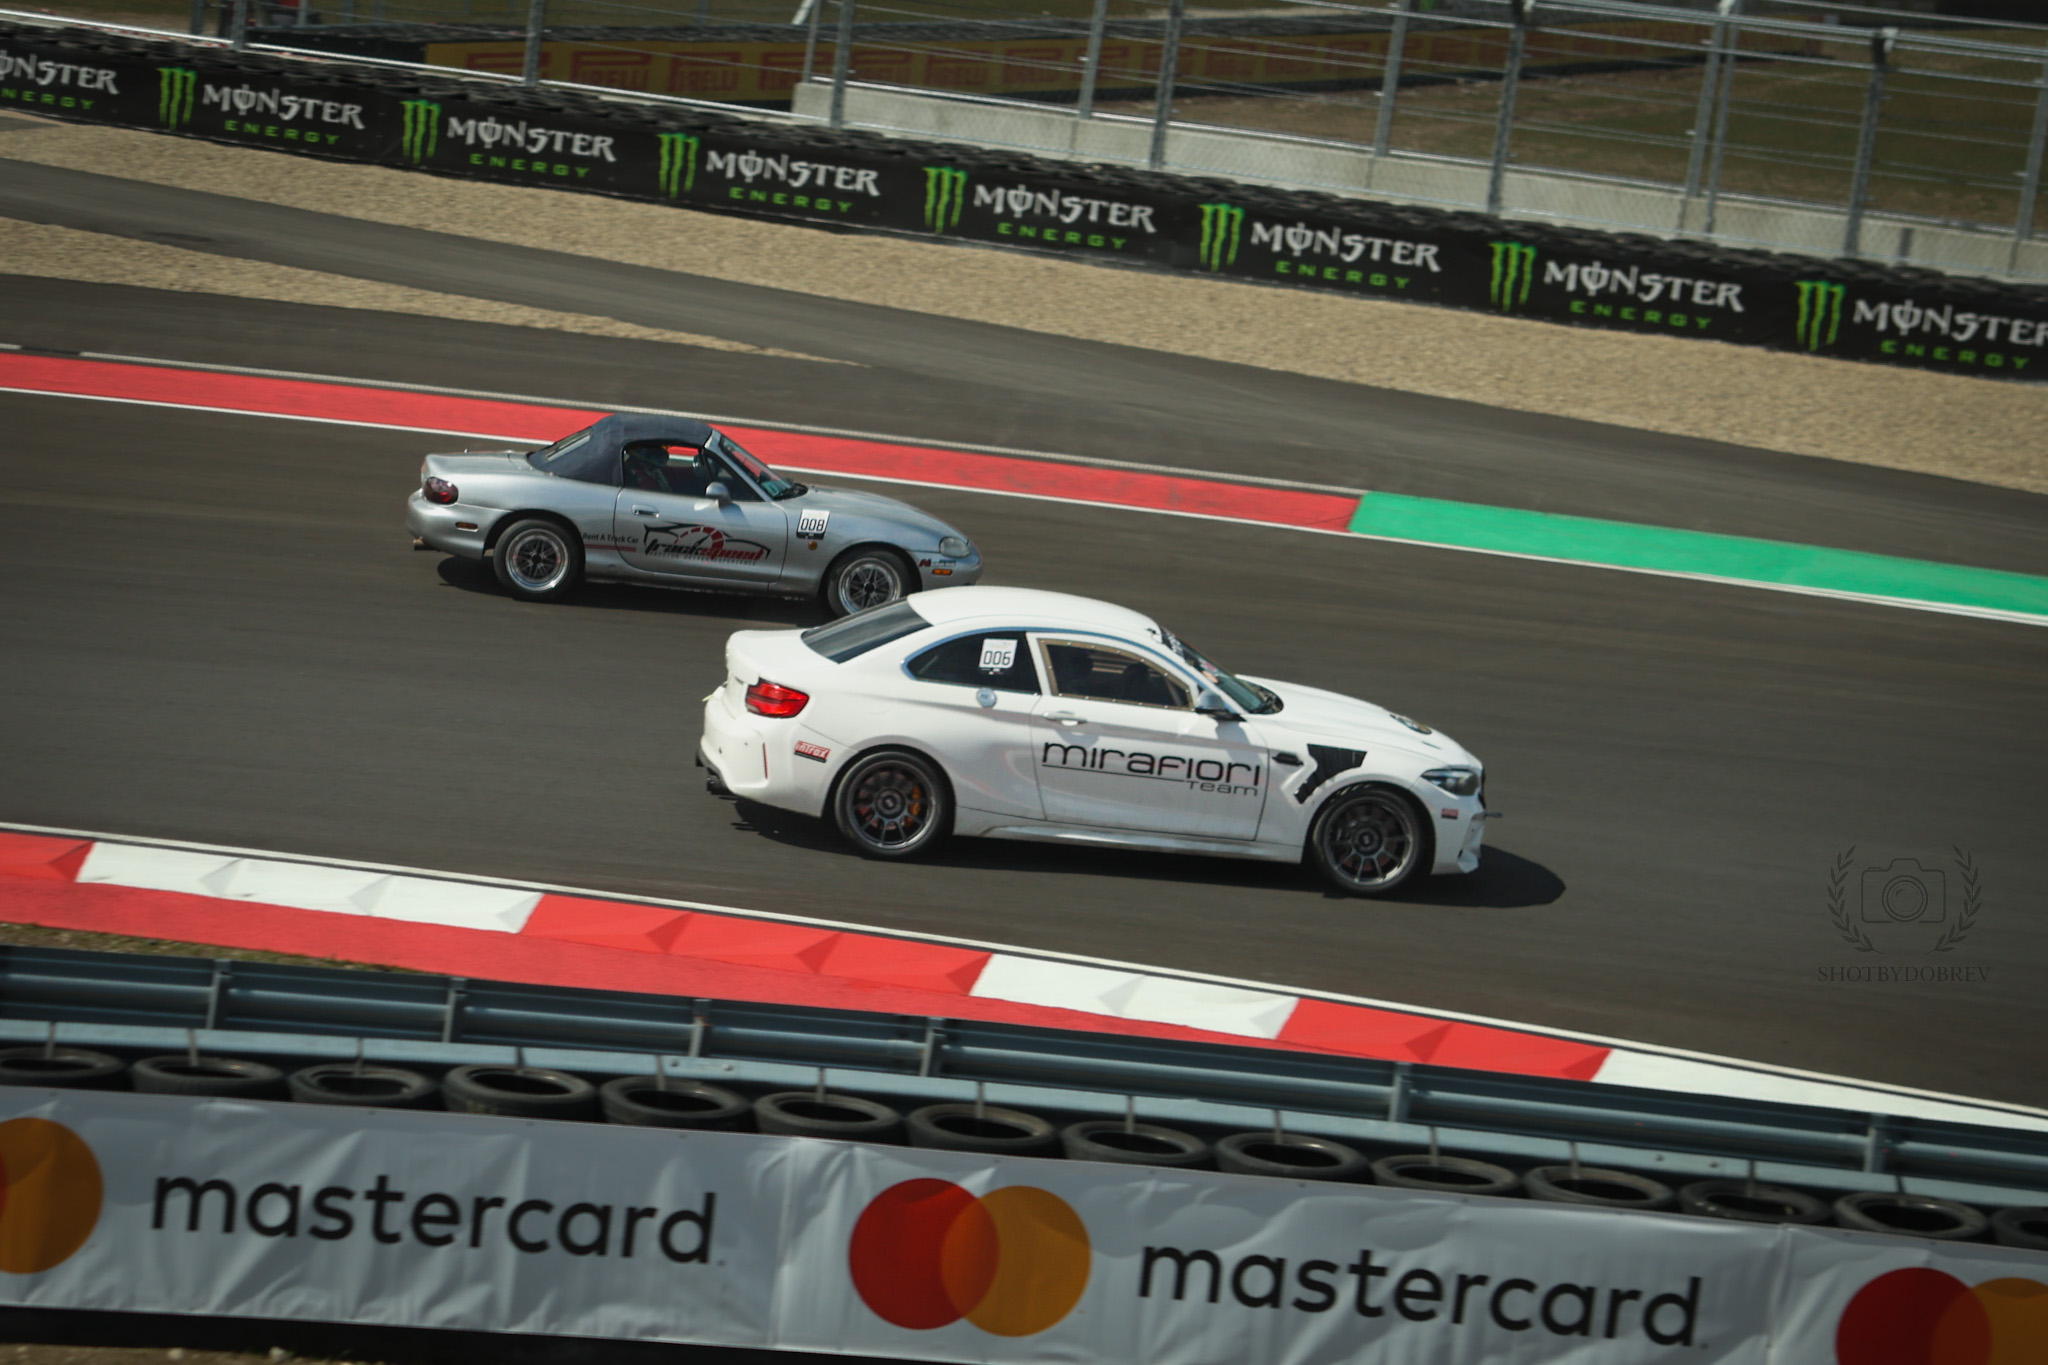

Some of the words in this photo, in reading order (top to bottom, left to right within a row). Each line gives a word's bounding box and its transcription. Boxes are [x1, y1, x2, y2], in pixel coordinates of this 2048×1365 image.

[0, 50, 119, 95] ONSTER
[1, 88, 94, 109] NERGY
[202, 83, 365, 130] MONSTER
[224, 119, 339, 145] ENERGY
[447, 117, 616, 163] MONSTER
[469, 153, 589, 178] ENERGY
[706, 150, 880, 197] MONSTER
[728, 186, 853, 213] ENERGY
[973, 184, 1156, 233] MONSTER
[996, 222, 1127, 250] ENERGY
[1250, 221, 1442, 272] MONSTER
[1275, 260, 1411, 289] ENERGY
[1543, 261, 1745, 312] MONSTER
[1570, 300, 1711, 329] ENERGY
[1880, 339, 2030, 369] ENERGY
[801, 518, 825, 531] 008
[983, 651, 1012, 666] 006
[1042, 742, 1260, 786] mirafiori
[152, 1175, 716, 1264] mastercard
[1139, 1246, 1702, 1347] mastercard
